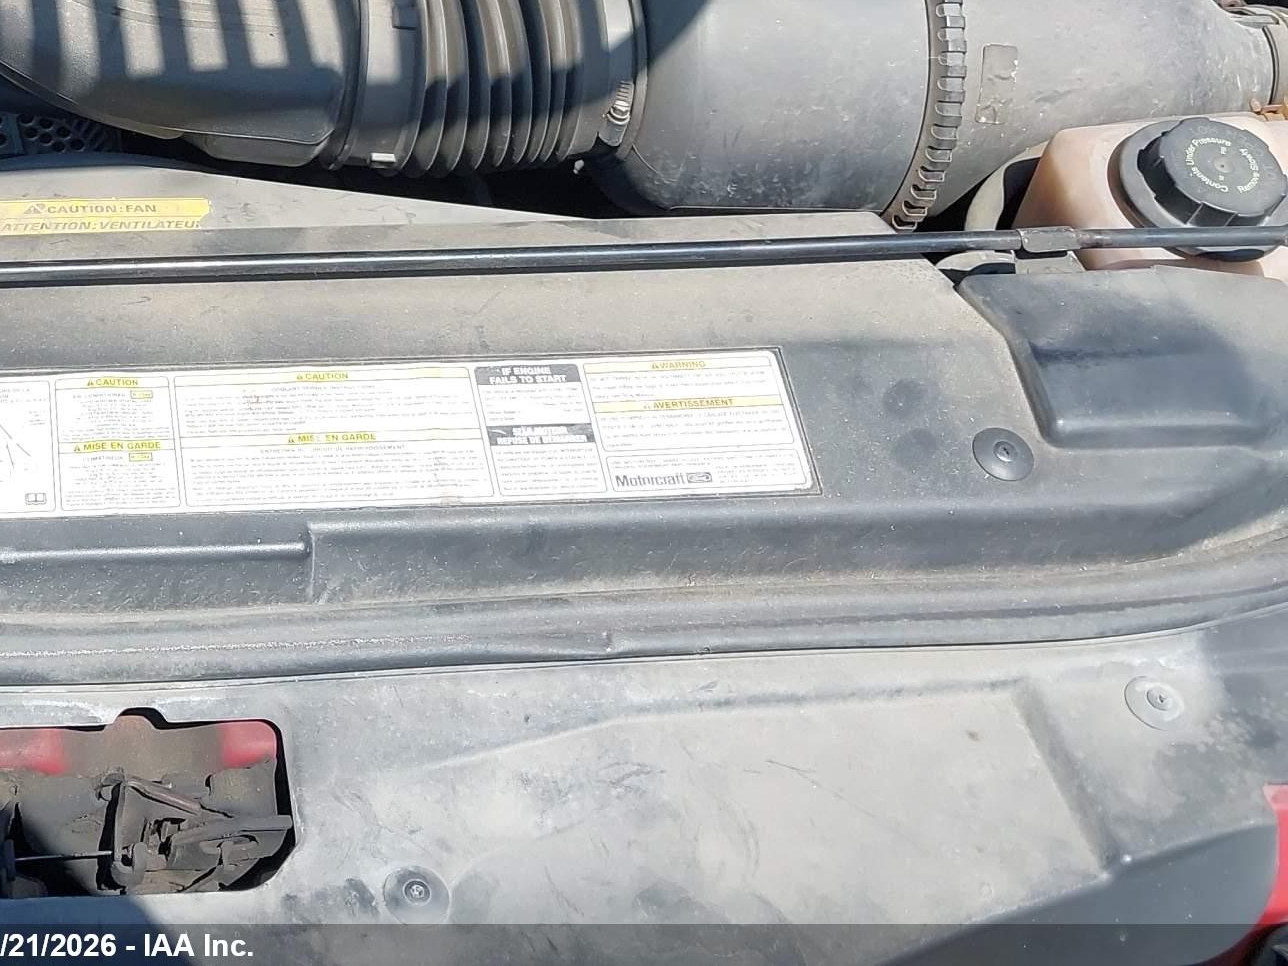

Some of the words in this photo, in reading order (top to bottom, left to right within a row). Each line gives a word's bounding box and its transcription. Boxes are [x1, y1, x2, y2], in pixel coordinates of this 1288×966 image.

[1185, 144, 1196, 166] Under
[1191, 137, 1232, 147] Pressure
[659, 359, 706, 369] WARNING
[305, 371, 349, 381] CAUTION
[502, 367, 511, 376] IF
[96, 378, 139, 387] CAUTION
[489, 376, 518, 385] FAILS
[519, 375, 534, 383] TO
[536, 374, 567, 383] START
[653, 398, 734, 409] AVERTISSEMENT
[325, 433, 339, 441] EN
[341, 432, 377, 441] GARDE
[83, 442, 108, 451] MISE
[110, 442, 125, 450] EN
[127, 441, 161, 449] GARDE
[615, 471, 686, 488] Motorcraft
